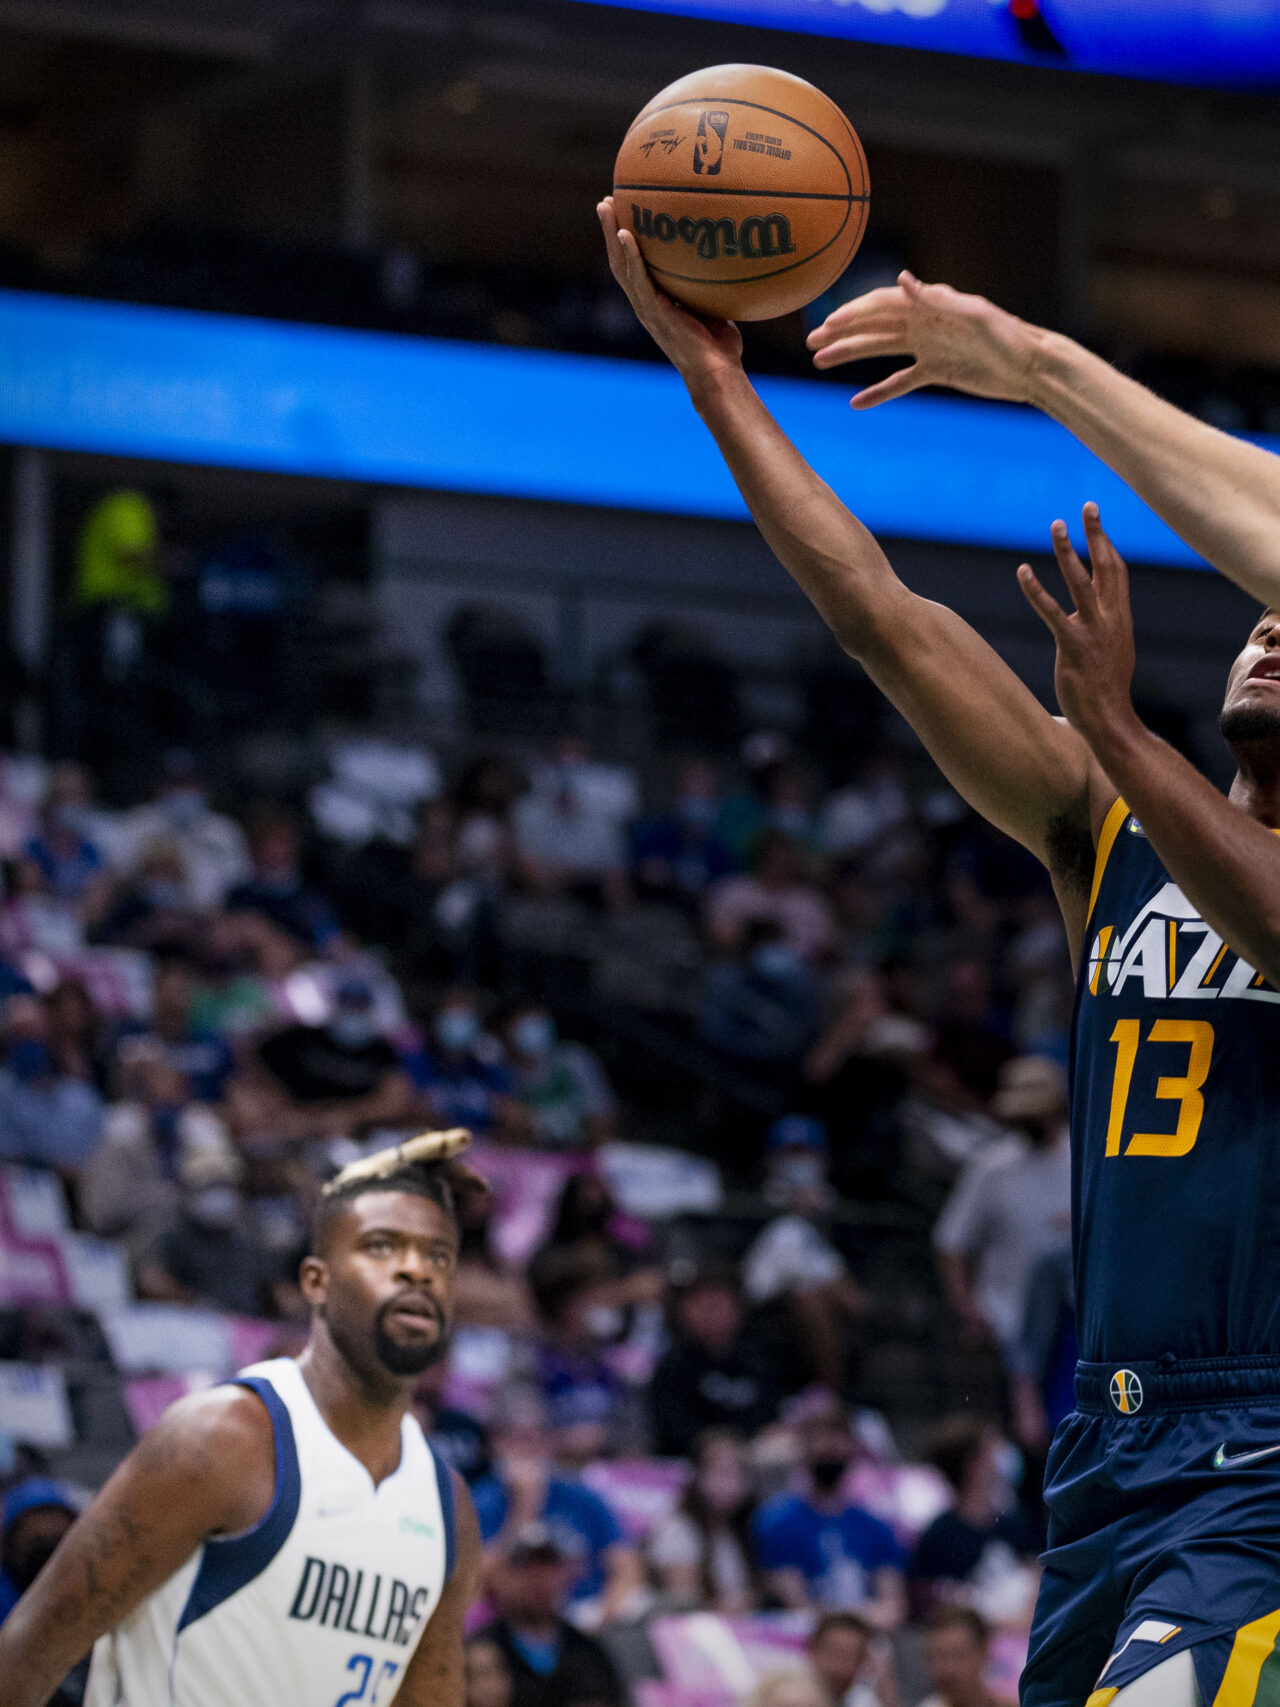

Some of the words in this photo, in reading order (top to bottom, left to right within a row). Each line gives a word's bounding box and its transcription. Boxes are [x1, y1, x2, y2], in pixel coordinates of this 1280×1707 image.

[733, 139, 748, 151] BALL
[766, 145, 792, 161] OFFICIAL
[631, 204, 796, 260] Wilson
[1105, 1018, 1216, 1158] 13
[288, 1555, 429, 1646] DALLAS
